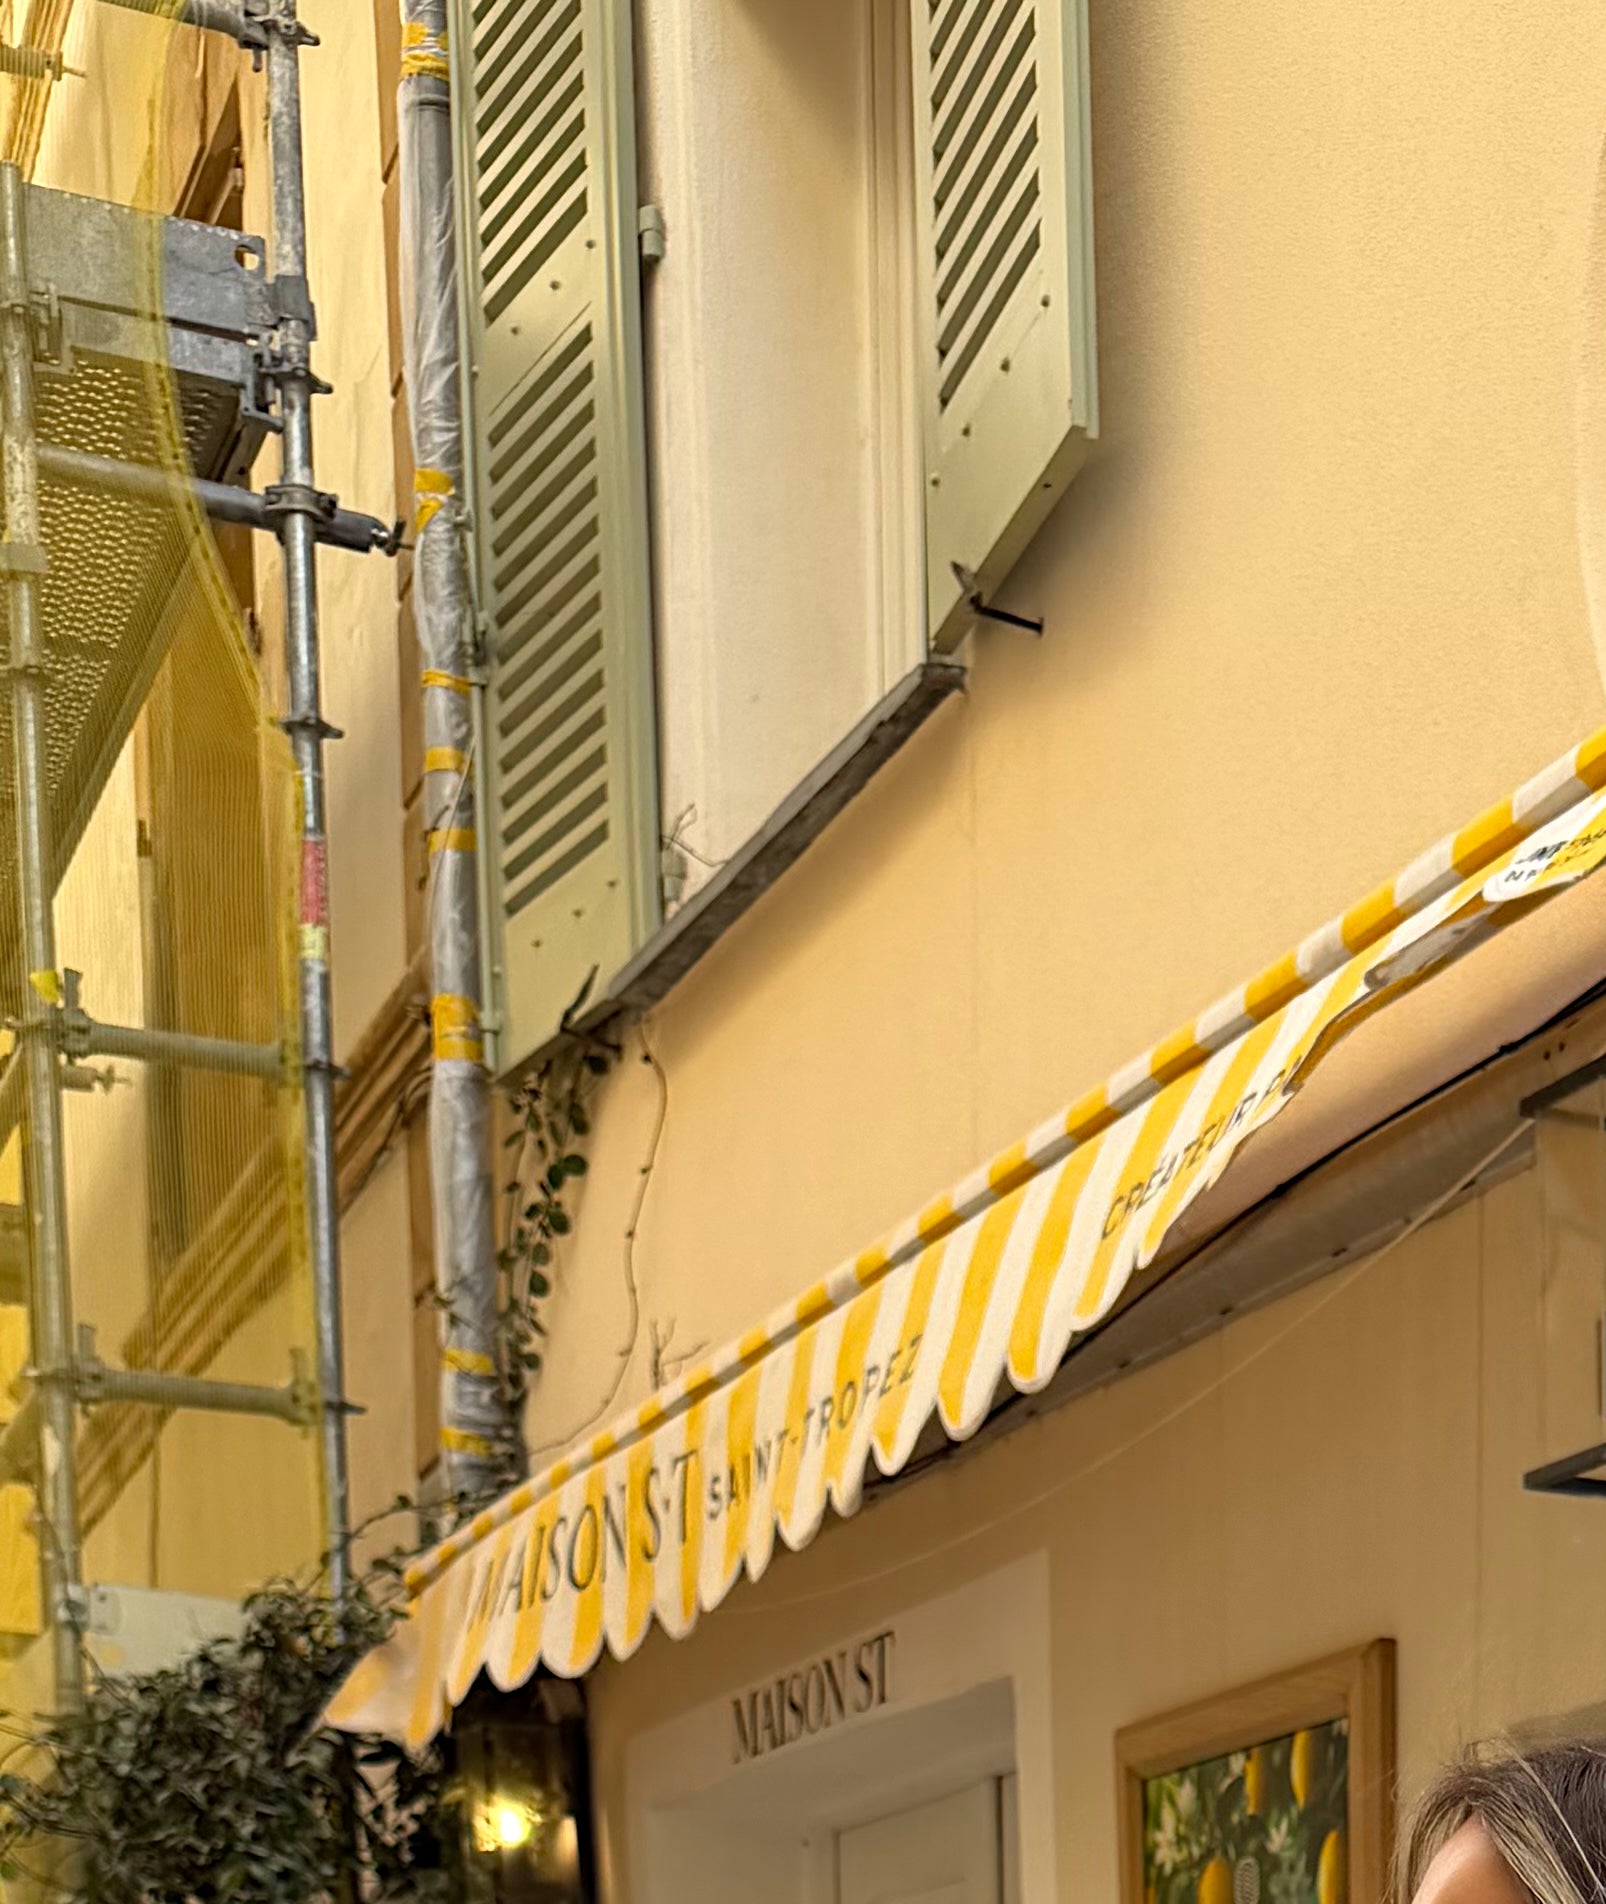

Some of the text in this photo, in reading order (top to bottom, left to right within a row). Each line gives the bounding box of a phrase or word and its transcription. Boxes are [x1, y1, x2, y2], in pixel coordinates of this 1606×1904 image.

[466, 1482, 631, 1633] MAISON
[708, 1333, 923, 1522] SAINT-TROPEZ
[730, 1629, 896, 1766] MAISON ST
